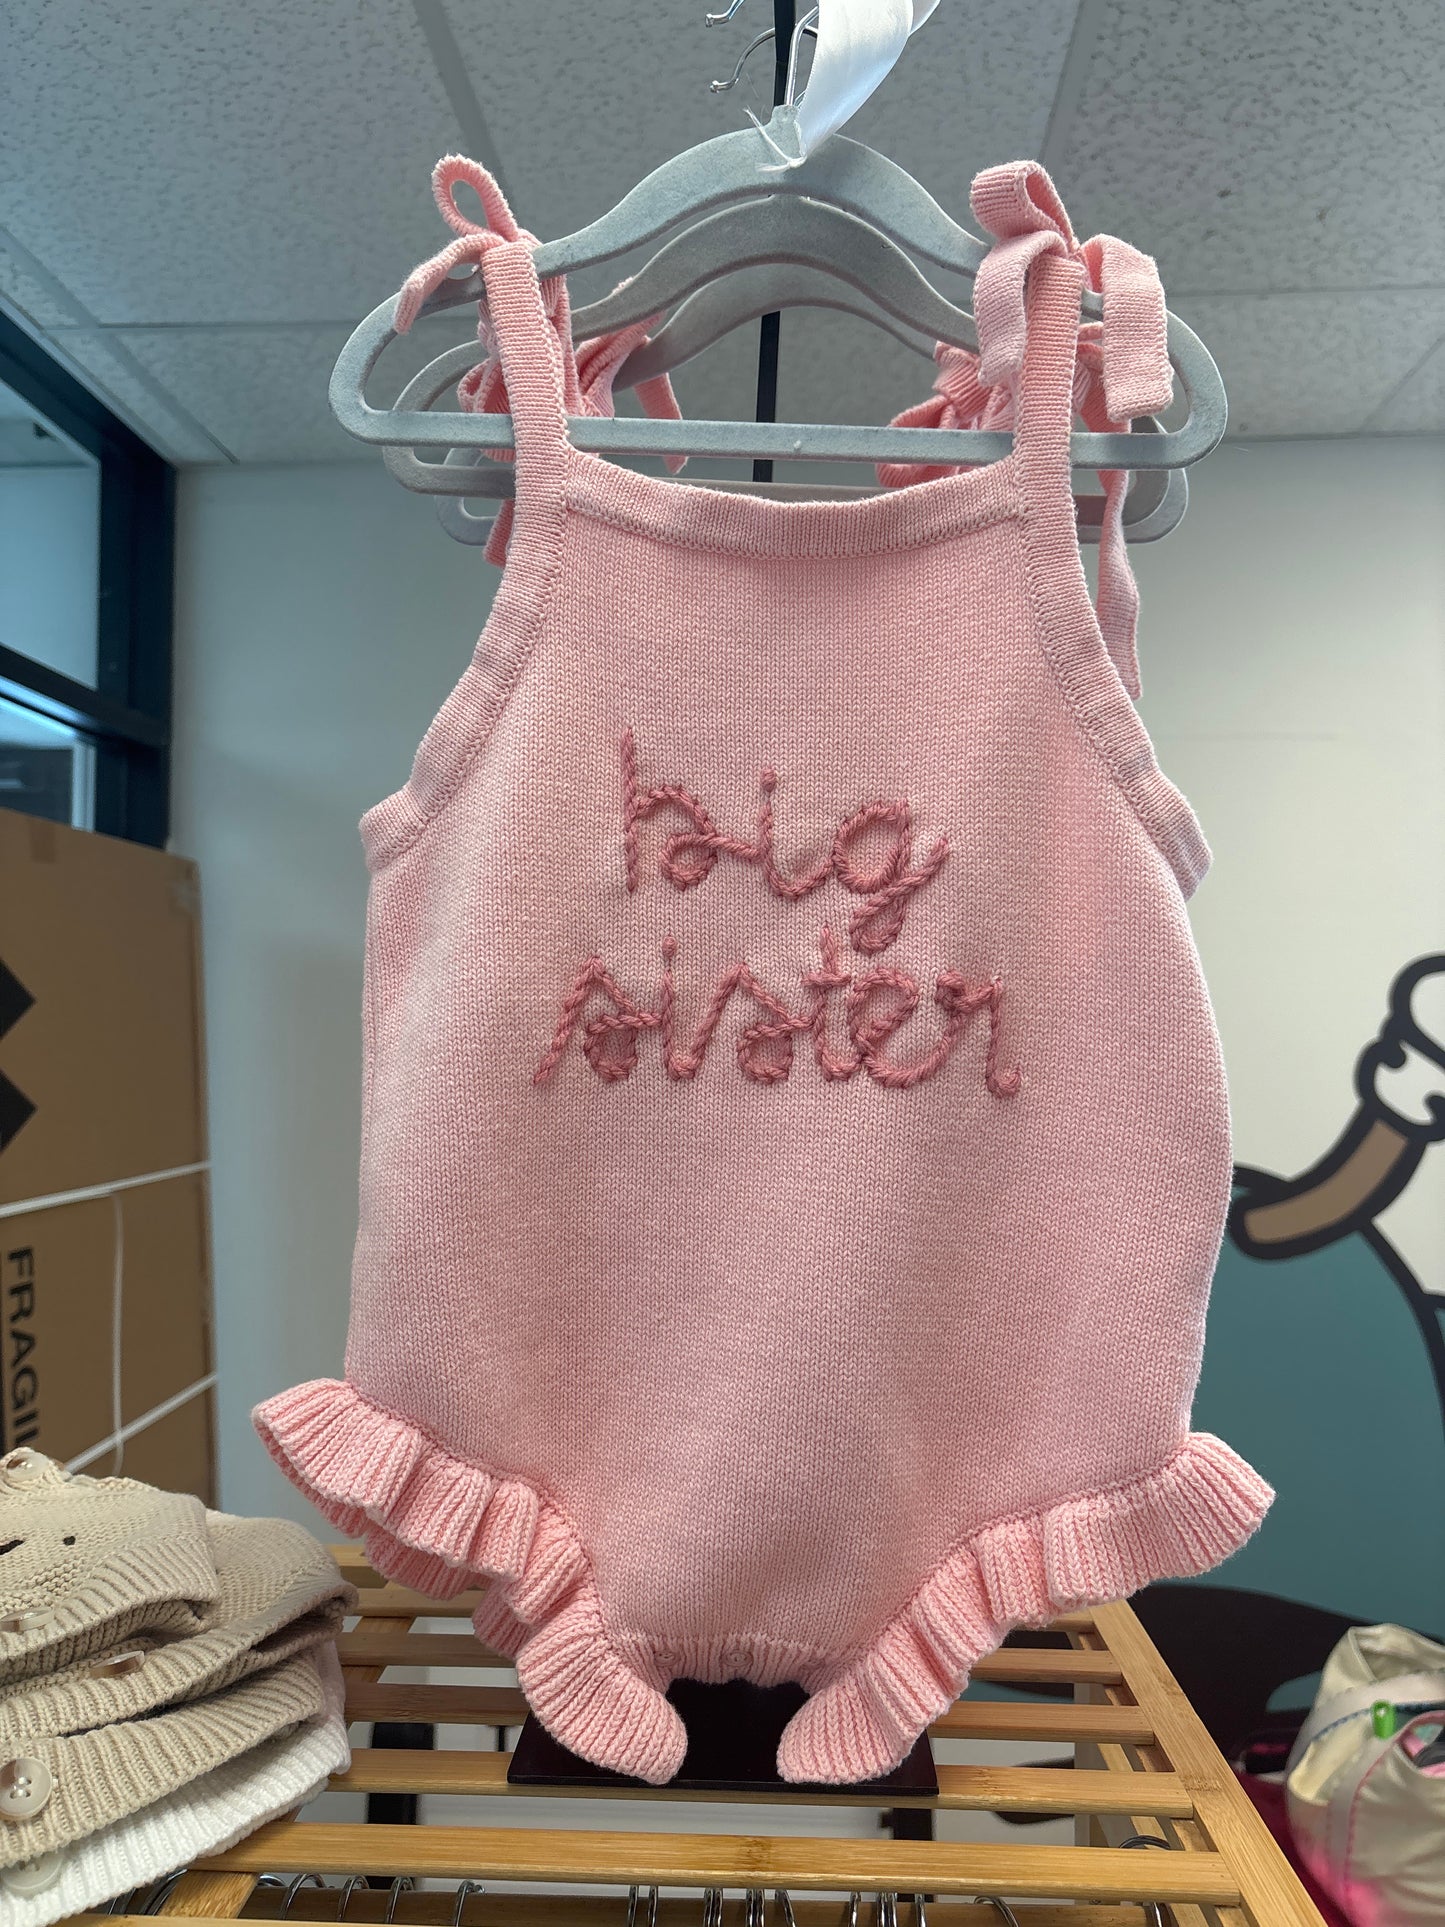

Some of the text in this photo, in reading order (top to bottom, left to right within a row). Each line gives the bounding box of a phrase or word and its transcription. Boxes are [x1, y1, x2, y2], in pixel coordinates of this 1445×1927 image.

[620, 726, 950, 955] big
[533, 925, 1022, 1099] sister
[7, 1246, 40, 1449] FRAGIL
